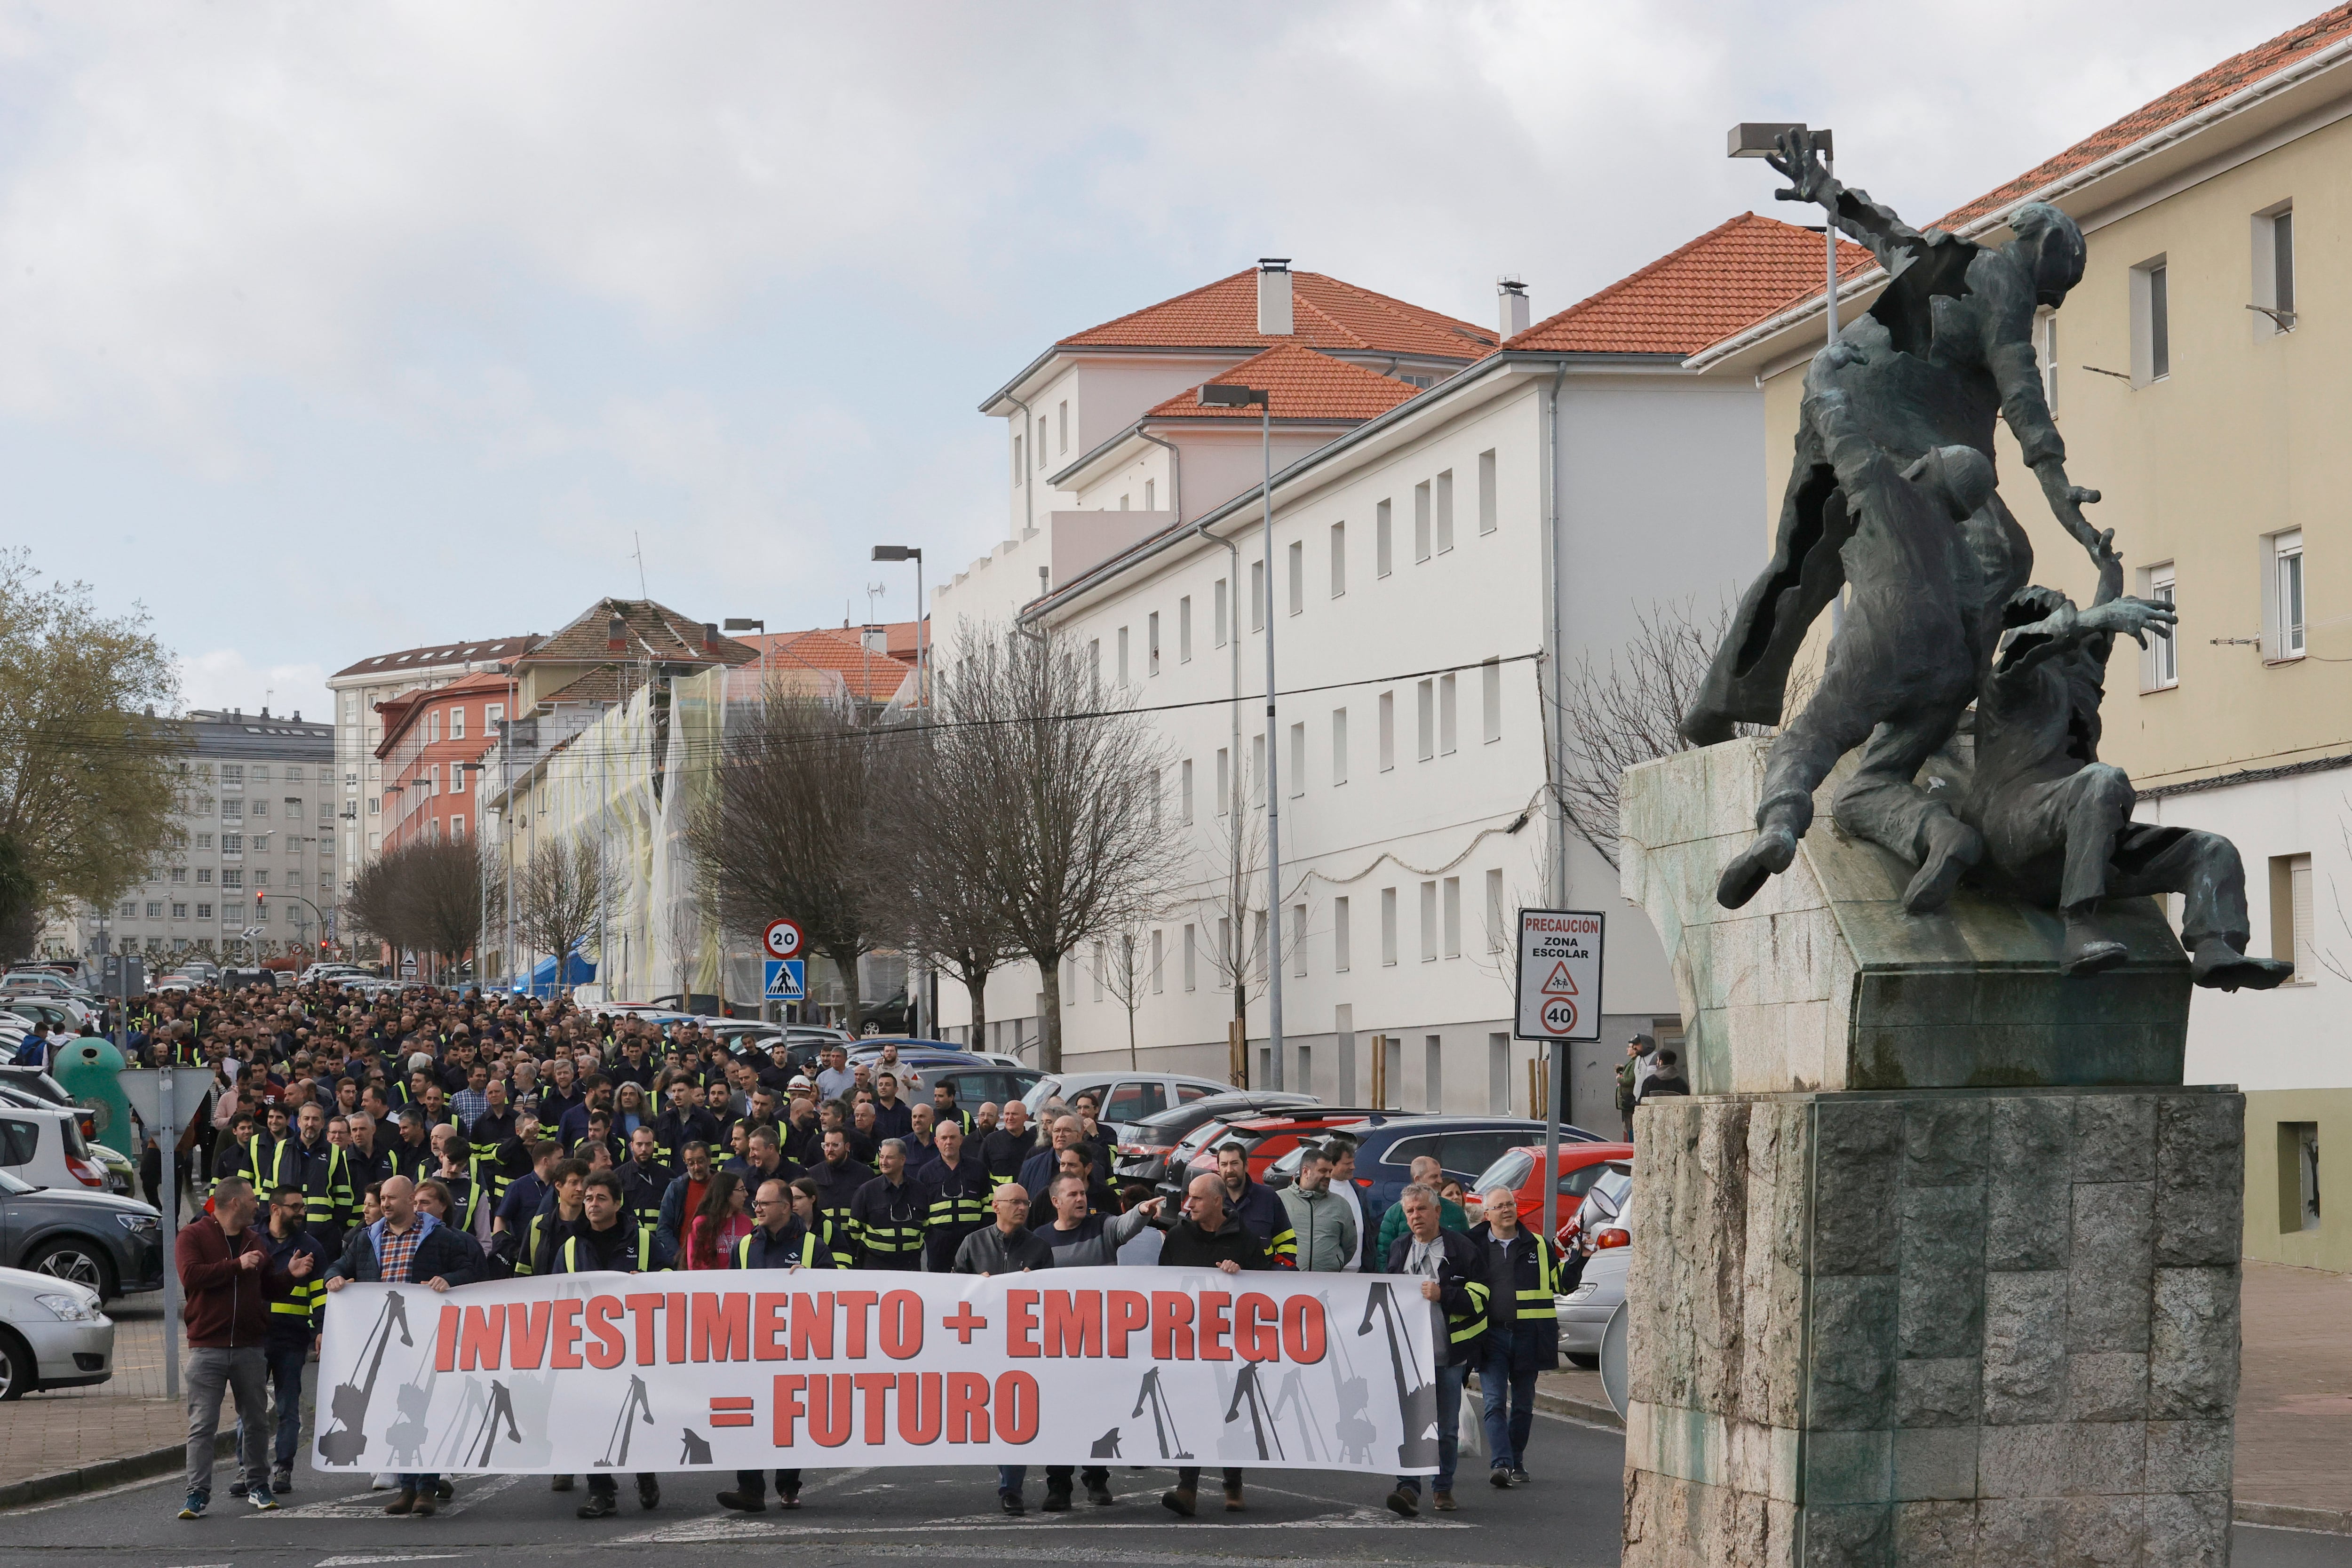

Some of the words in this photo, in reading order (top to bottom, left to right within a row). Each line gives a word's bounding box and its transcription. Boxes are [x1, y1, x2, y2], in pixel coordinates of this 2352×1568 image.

[1526, 917, 1598, 933] PRECAUCIÓN
[773, 933, 794, 945] 20
[1544, 937, 1578, 946] ZONA
[1533, 948, 1589, 958] ESCOLAR
[1547, 1008, 1571, 1023] 40
[435, 1289, 924, 1372] INVESTIMENTO
[942, 1301, 987, 1344] +
[1006, 1289, 1327, 1365] EMPREGO
[709, 1396, 754, 1427] =
[773, 1370, 1040, 1448] FUTURO
